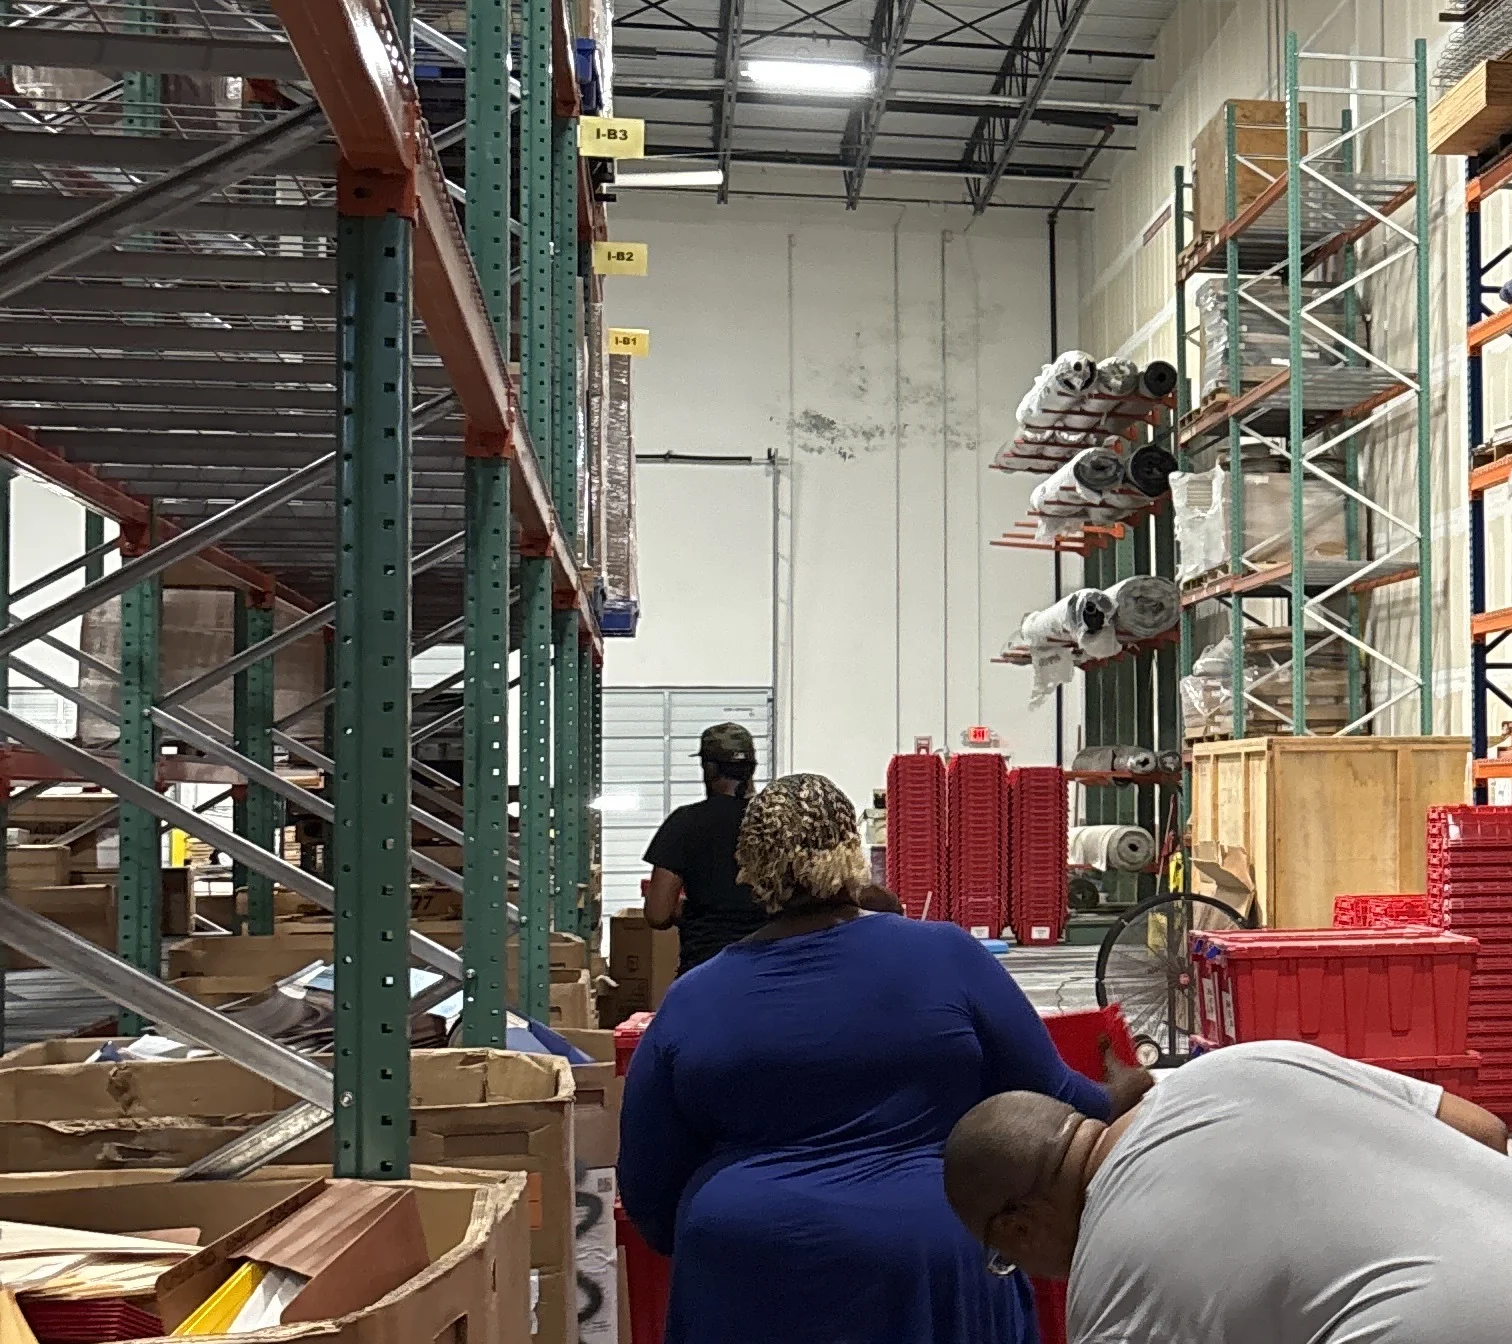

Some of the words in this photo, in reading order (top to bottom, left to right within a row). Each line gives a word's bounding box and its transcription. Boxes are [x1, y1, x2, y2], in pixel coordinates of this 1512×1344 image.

[596, 128, 629, 141] I-B3
[607, 251, 634, 262] I-B2
[615, 336, 637, 346] I-B1
